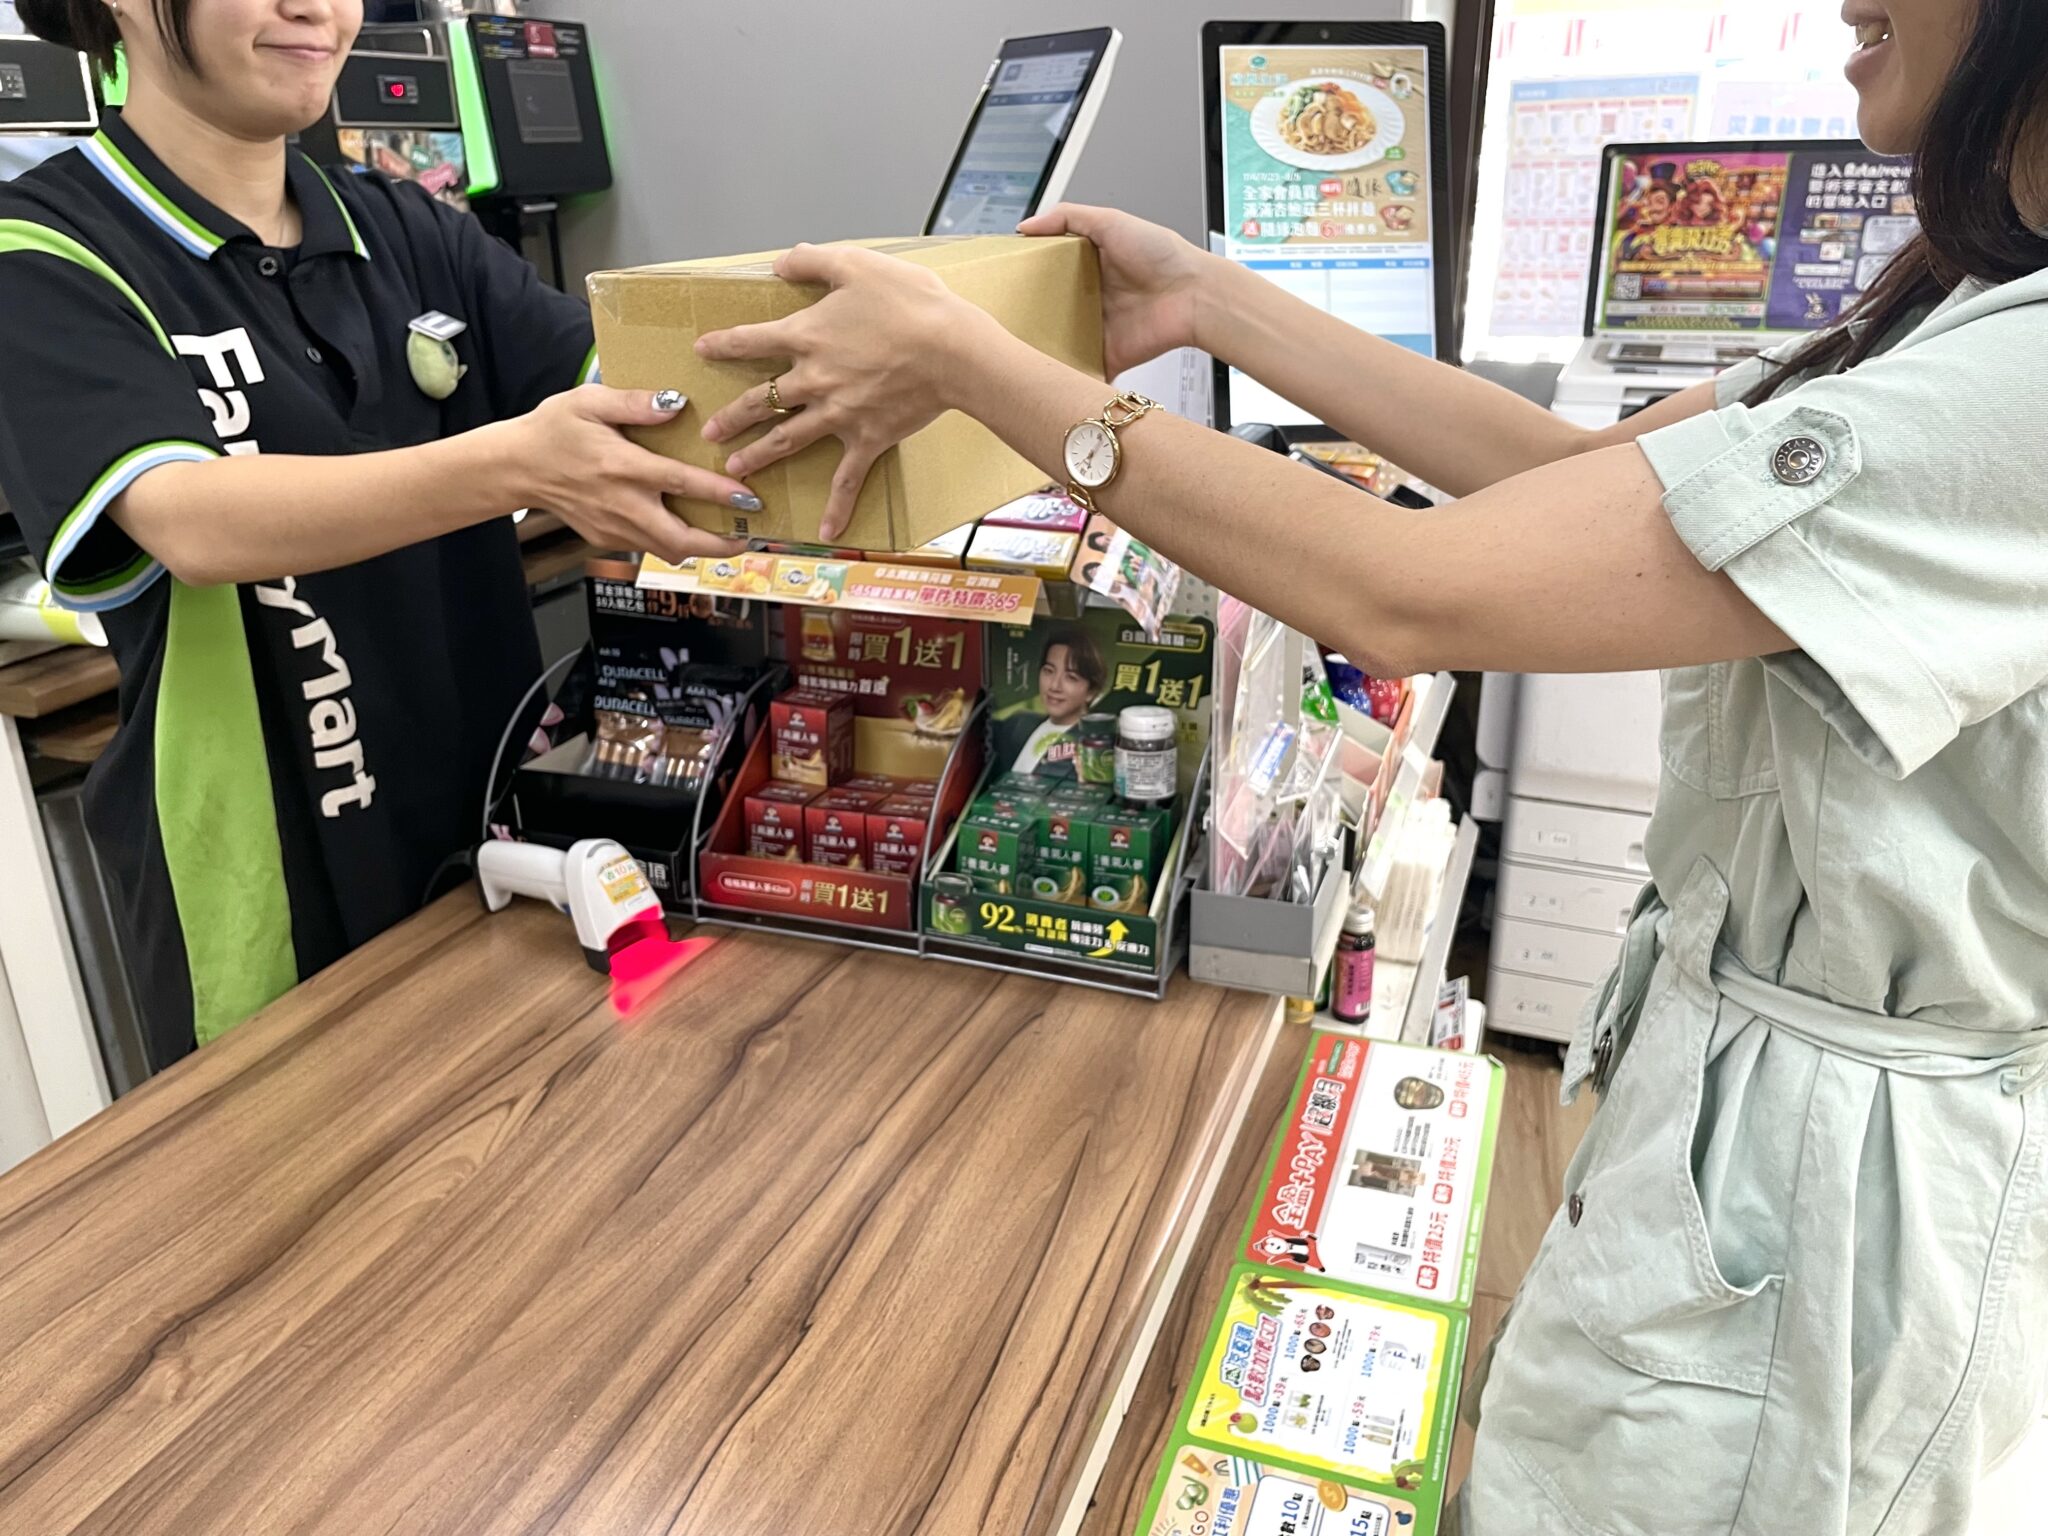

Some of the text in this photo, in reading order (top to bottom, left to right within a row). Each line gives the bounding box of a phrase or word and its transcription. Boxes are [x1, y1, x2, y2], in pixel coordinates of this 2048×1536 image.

[861, 626, 965, 671] 買1送1
[602, 664, 668, 681] DURACELL
[1113, 659, 1204, 709] 買1送1
[595, 694, 658, 718] DURACELL
[814, 880, 889, 915] 買1送1
[1421, 1212, 1449, 1264] 特價25元
